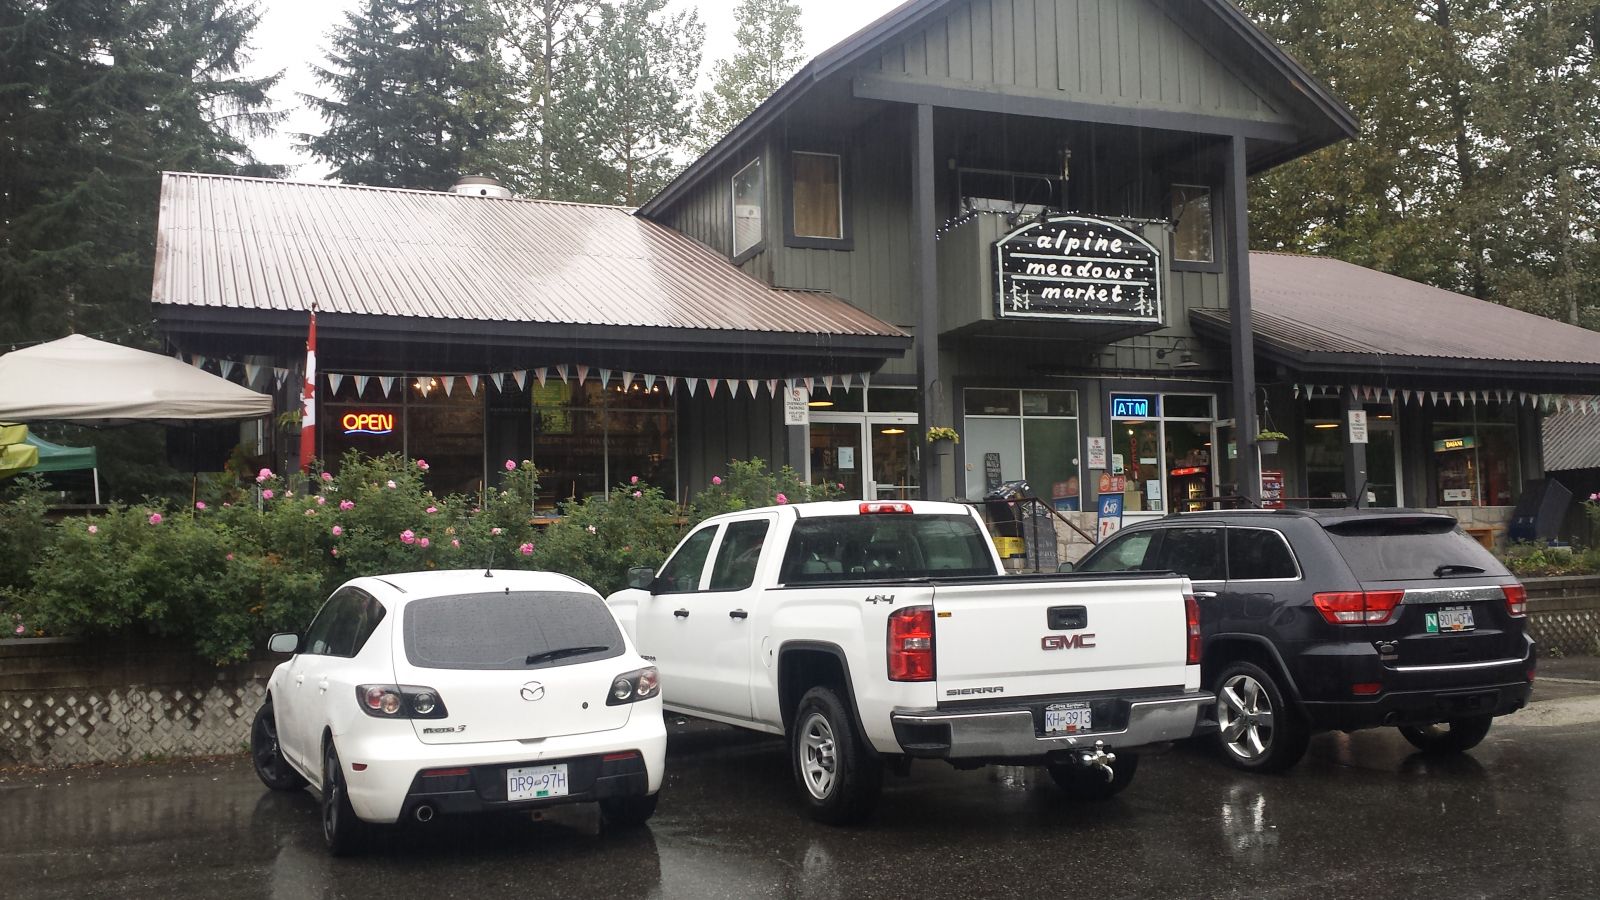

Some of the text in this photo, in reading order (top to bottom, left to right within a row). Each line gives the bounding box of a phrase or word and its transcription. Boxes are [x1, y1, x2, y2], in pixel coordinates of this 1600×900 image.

[1037, 230, 1122, 255] alpine
[1026, 262, 1134, 280] meadows
[1041, 285, 1123, 302] market
[1117, 402, 1146, 415] ATM
[342, 413, 393, 430] OPEN
[1427, 615, 1437, 627] N
[1041, 633, 1096, 651] GMC
[946, 686, 1004, 696] SIERRA
